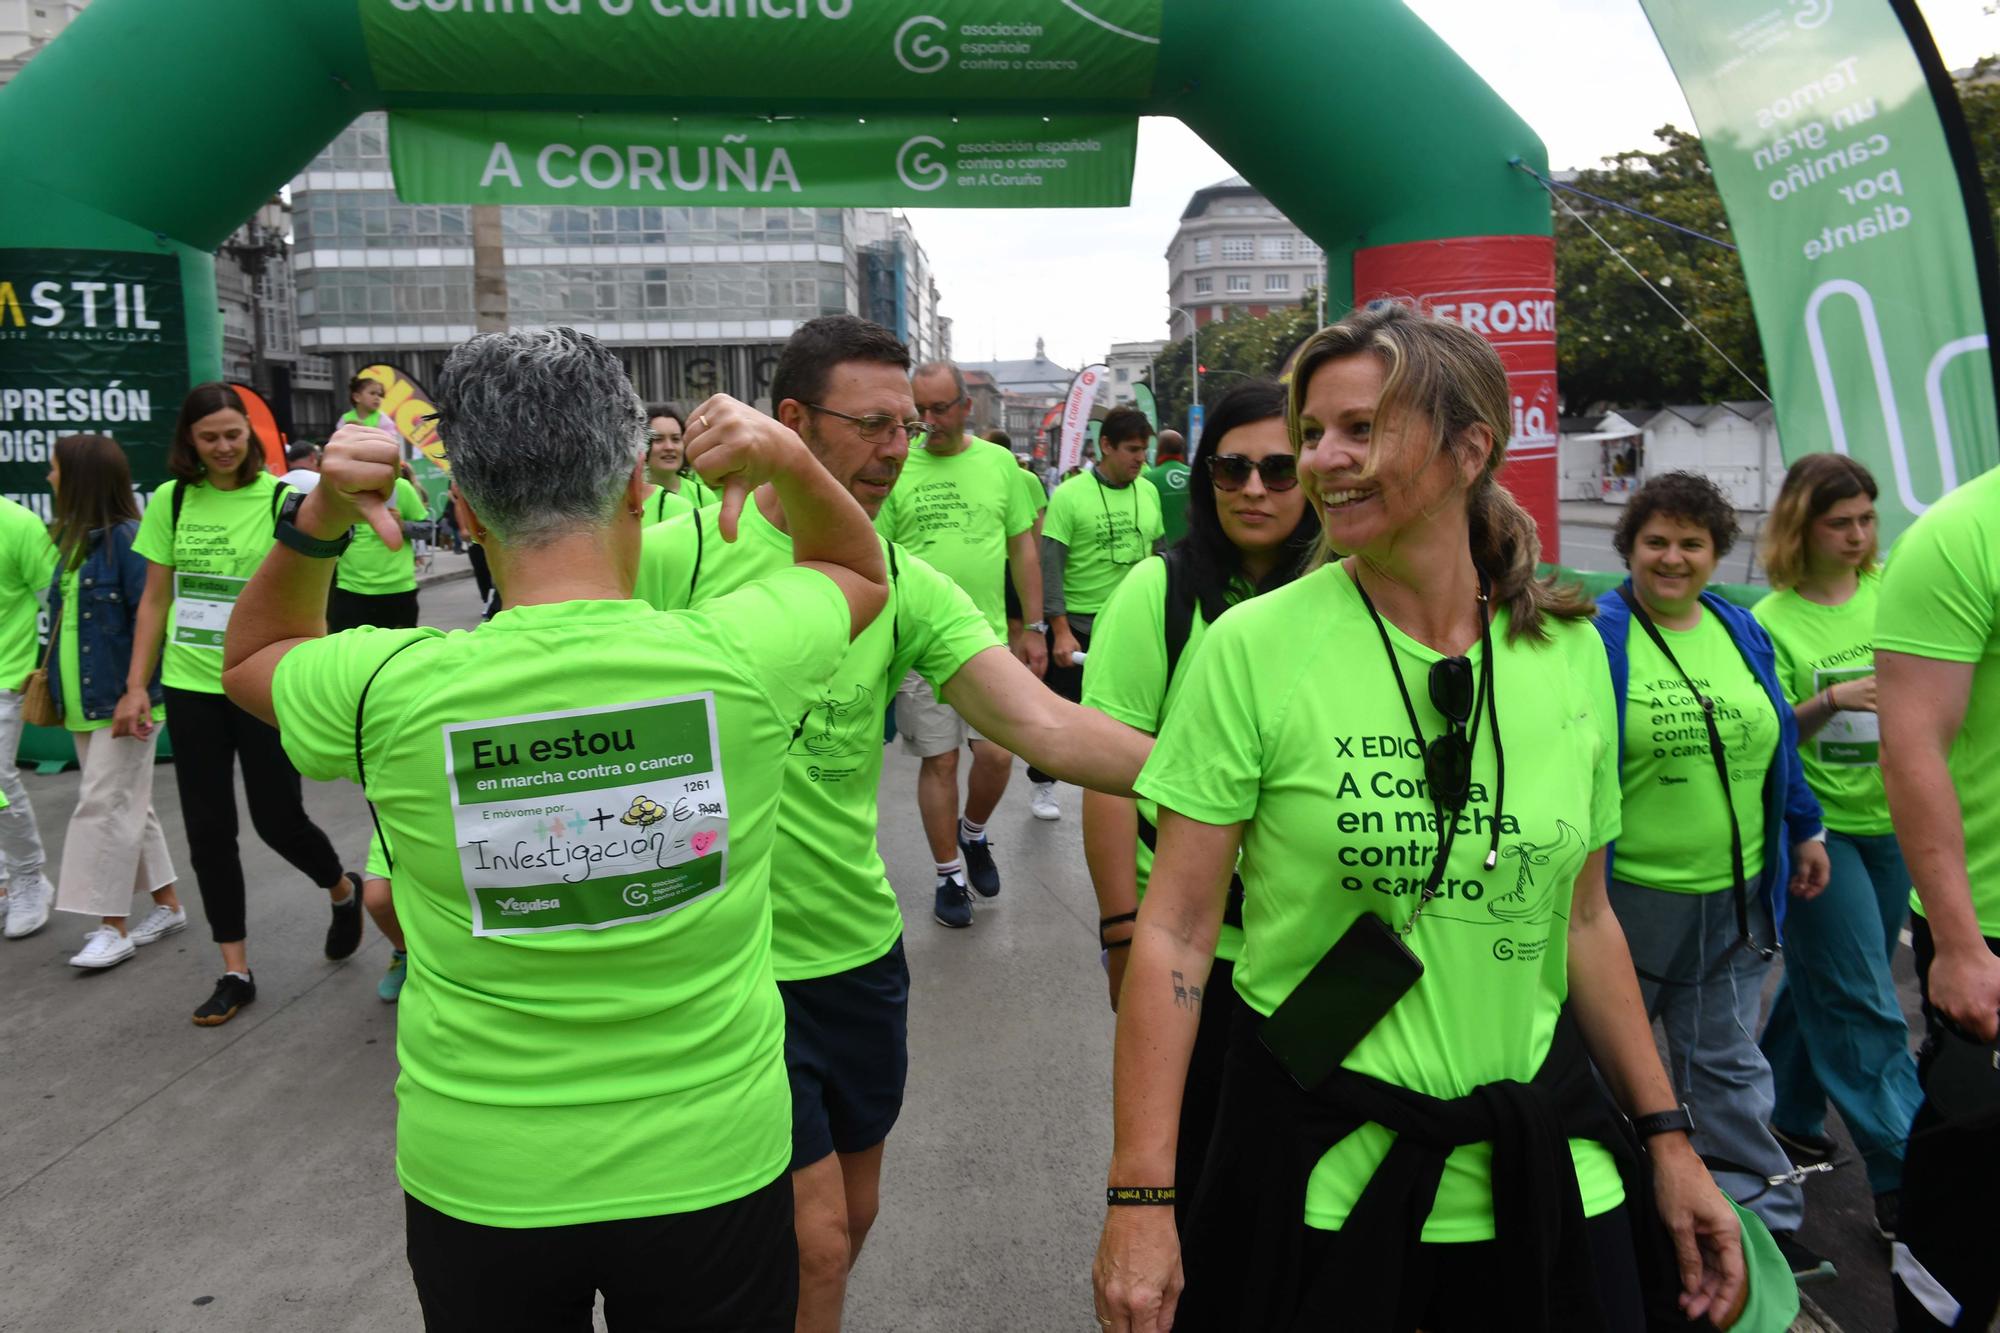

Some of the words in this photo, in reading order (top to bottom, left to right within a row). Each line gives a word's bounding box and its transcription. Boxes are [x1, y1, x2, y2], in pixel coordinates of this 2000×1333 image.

[960, 22, 1043, 36] asociación
[960, 41, 1031, 56] española
[479, 141, 523, 188] A
[536, 134, 803, 192] CORUÑA
[957, 175, 976, 186] en
[978, 174, 989, 185] A
[990, 172, 1043, 186] Coruña
[0, 380, 151, 421] PRESIÓN
[0, 430, 113, 462] DIGI
[1650, 697, 1664, 709] A
[1652, 713, 1676, 725] en
[1681, 707, 1742, 722] macha
[472, 740, 519, 770] Eu
[529, 729, 635, 762] estou
[1334, 737, 1355, 758] X
[1653, 749, 1666, 758] o
[476, 776, 498, 792] en
[501, 770, 564, 789] marcha
[567, 762, 622, 782] contra
[625, 762, 635, 773] o
[639, 753, 694, 772] cancro
[683, 780, 710, 792] 1261
[1336, 772, 1362, 799] A
[1370, 771, 1489, 803] Cora
[482, 811, 490, 820] E
[492, 807, 542, 818] móvome
[1337, 811, 1384, 833] en
[1341, 876, 1363, 891] o
[496, 897, 560, 914] Vegalsa
